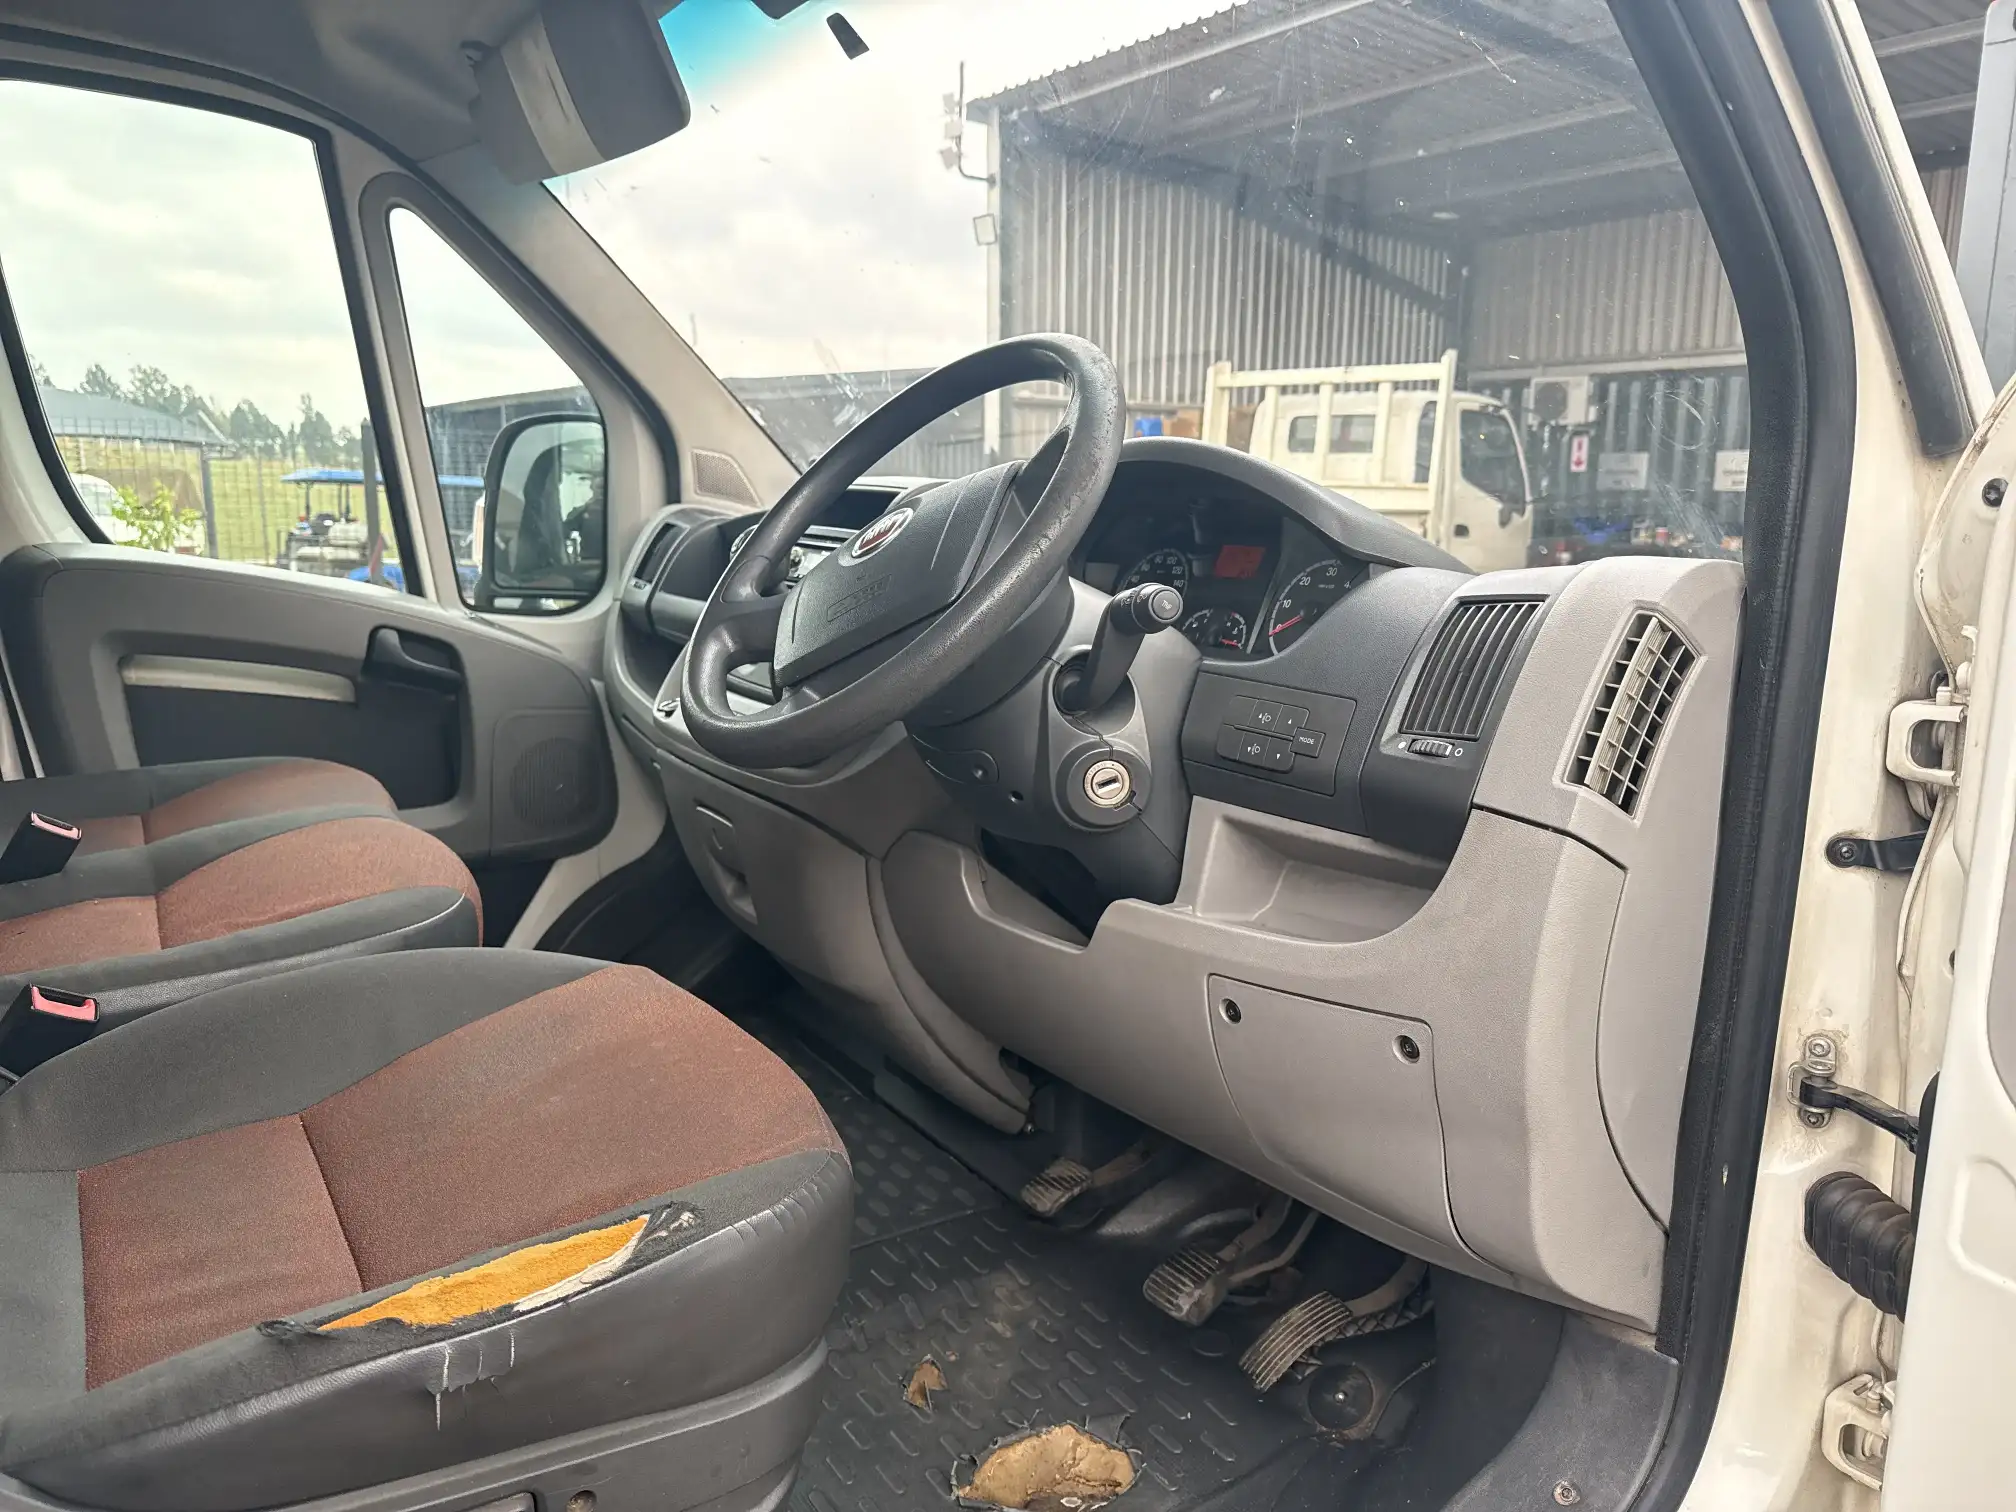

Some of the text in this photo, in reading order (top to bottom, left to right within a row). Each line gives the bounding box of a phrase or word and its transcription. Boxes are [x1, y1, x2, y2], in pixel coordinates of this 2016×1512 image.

[1172, 566, 1183, 575] 120
[1326, 567, 1338, 577] 30
[1299, 576, 1311, 586] 20
[1282, 599, 1292, 609] 10
[1299, 736, 1315, 745] MODE
